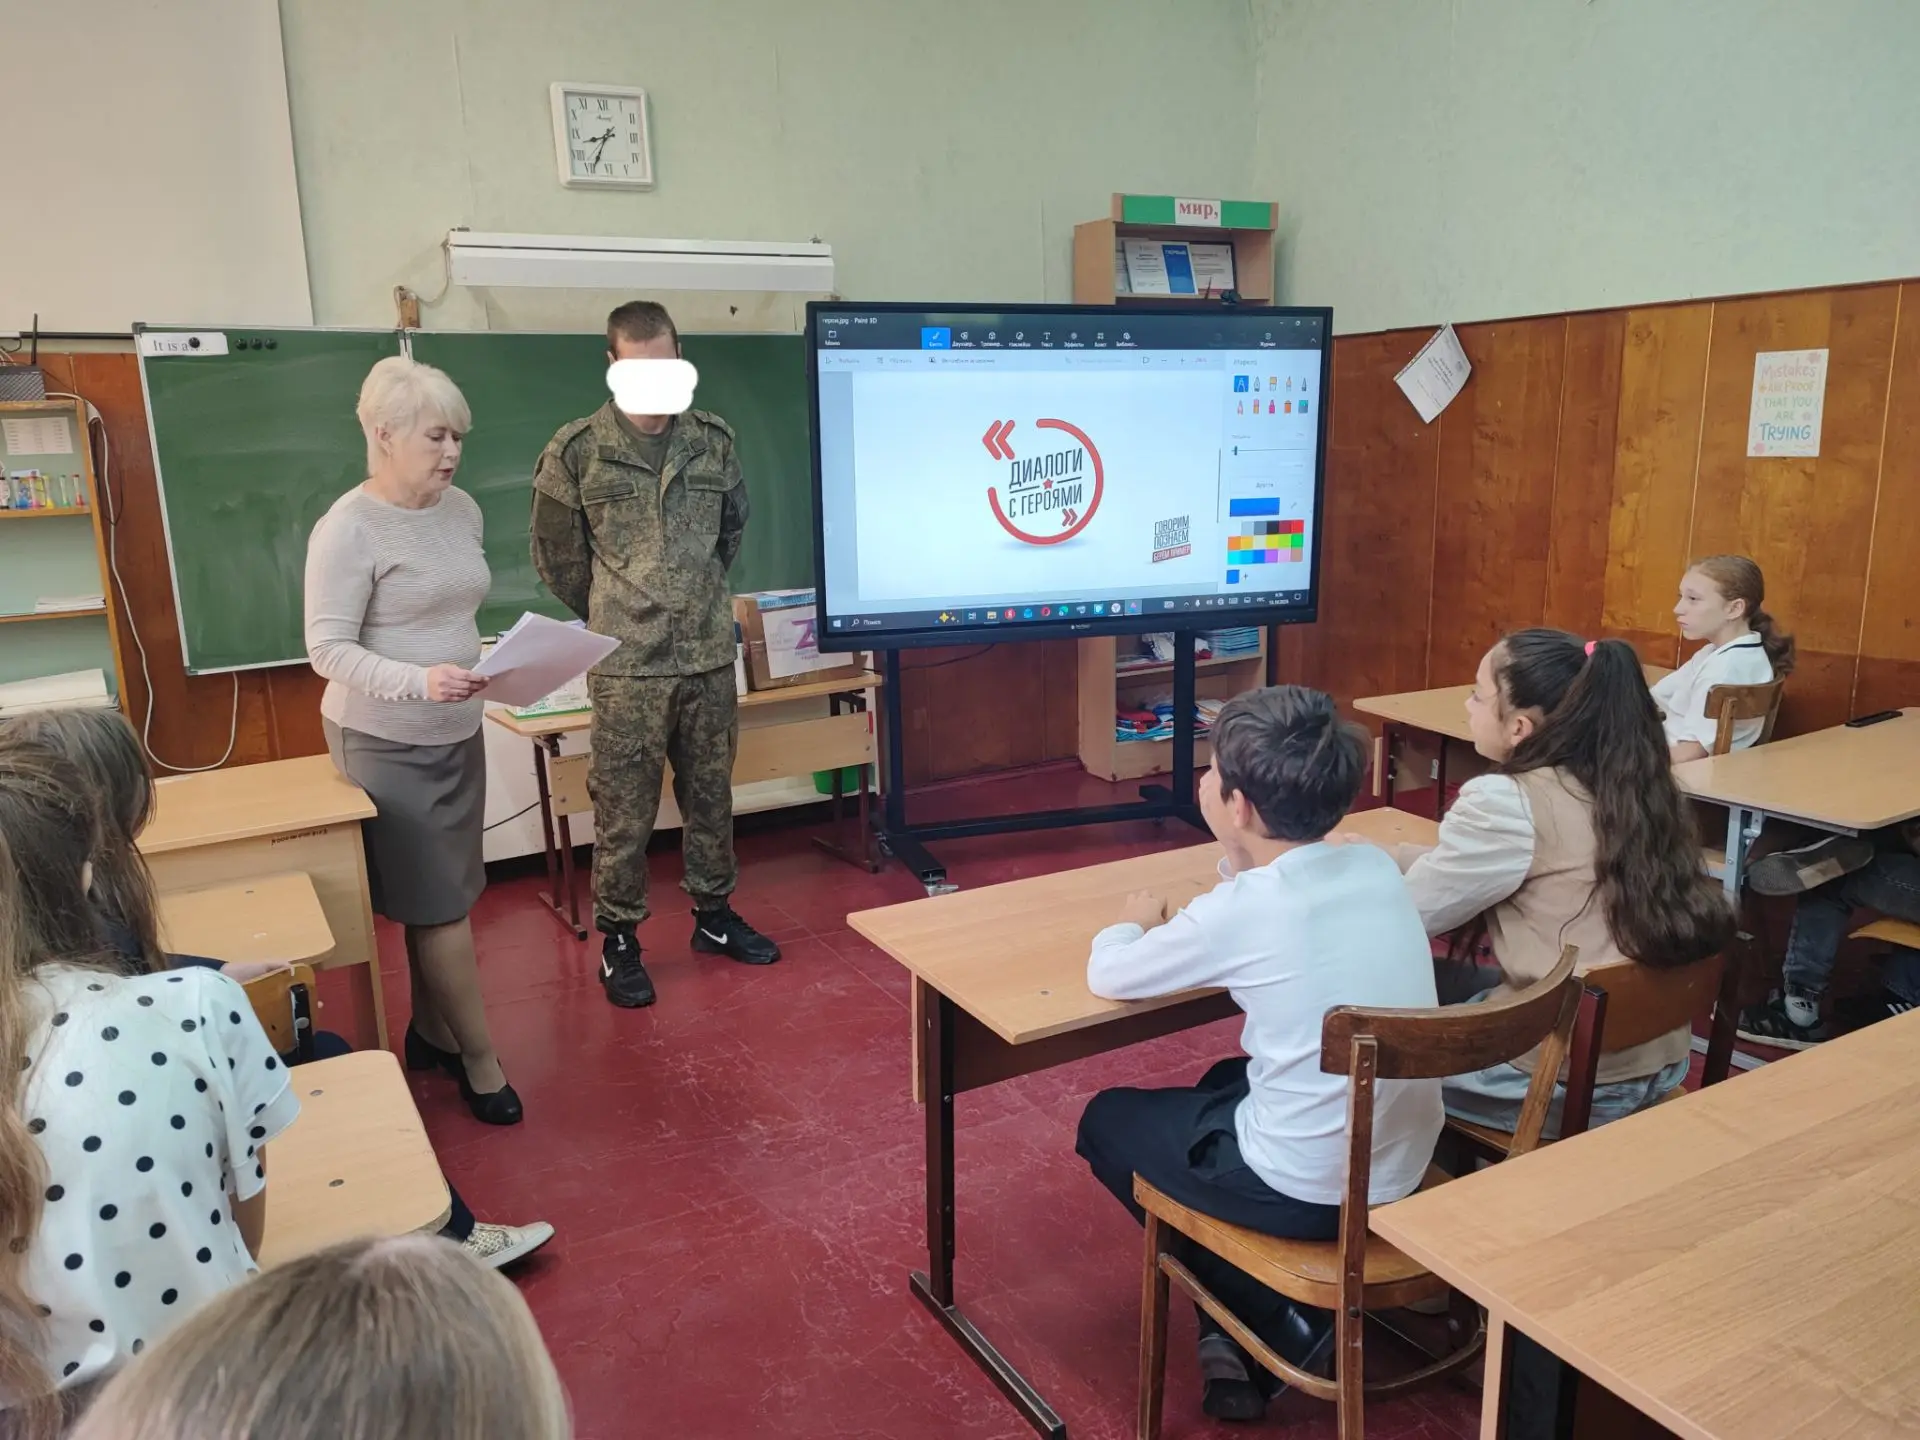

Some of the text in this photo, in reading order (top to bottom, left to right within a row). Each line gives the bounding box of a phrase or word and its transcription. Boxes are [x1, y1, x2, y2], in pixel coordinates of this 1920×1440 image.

[579, 97, 588, 110] XI
[597, 98, 609, 111] XII
[571, 108, 577, 120] X
[629, 112, 636, 125] II
[572, 127, 581, 140] IX
[629, 132, 638, 145] III
[571, 149, 585, 161] VIII
[631, 152, 640, 164] IV
[584, 162, 596, 175] VII
[604, 163, 613, 175] VI
[624, 164, 629, 176] V
[1179, 202, 1219, 220] мир,
[154, 340, 163, 352] It
[168, 340, 178, 352] is
[1763, 395, 1812, 409] THAT YOU
[1775, 410, 1794, 421] ARE
[1759, 422, 1811, 441] TRYING
[1009, 447, 1083, 490] ДИАЛОГИ
[1009, 484, 1082, 518] С ГЕРОЯМИ
